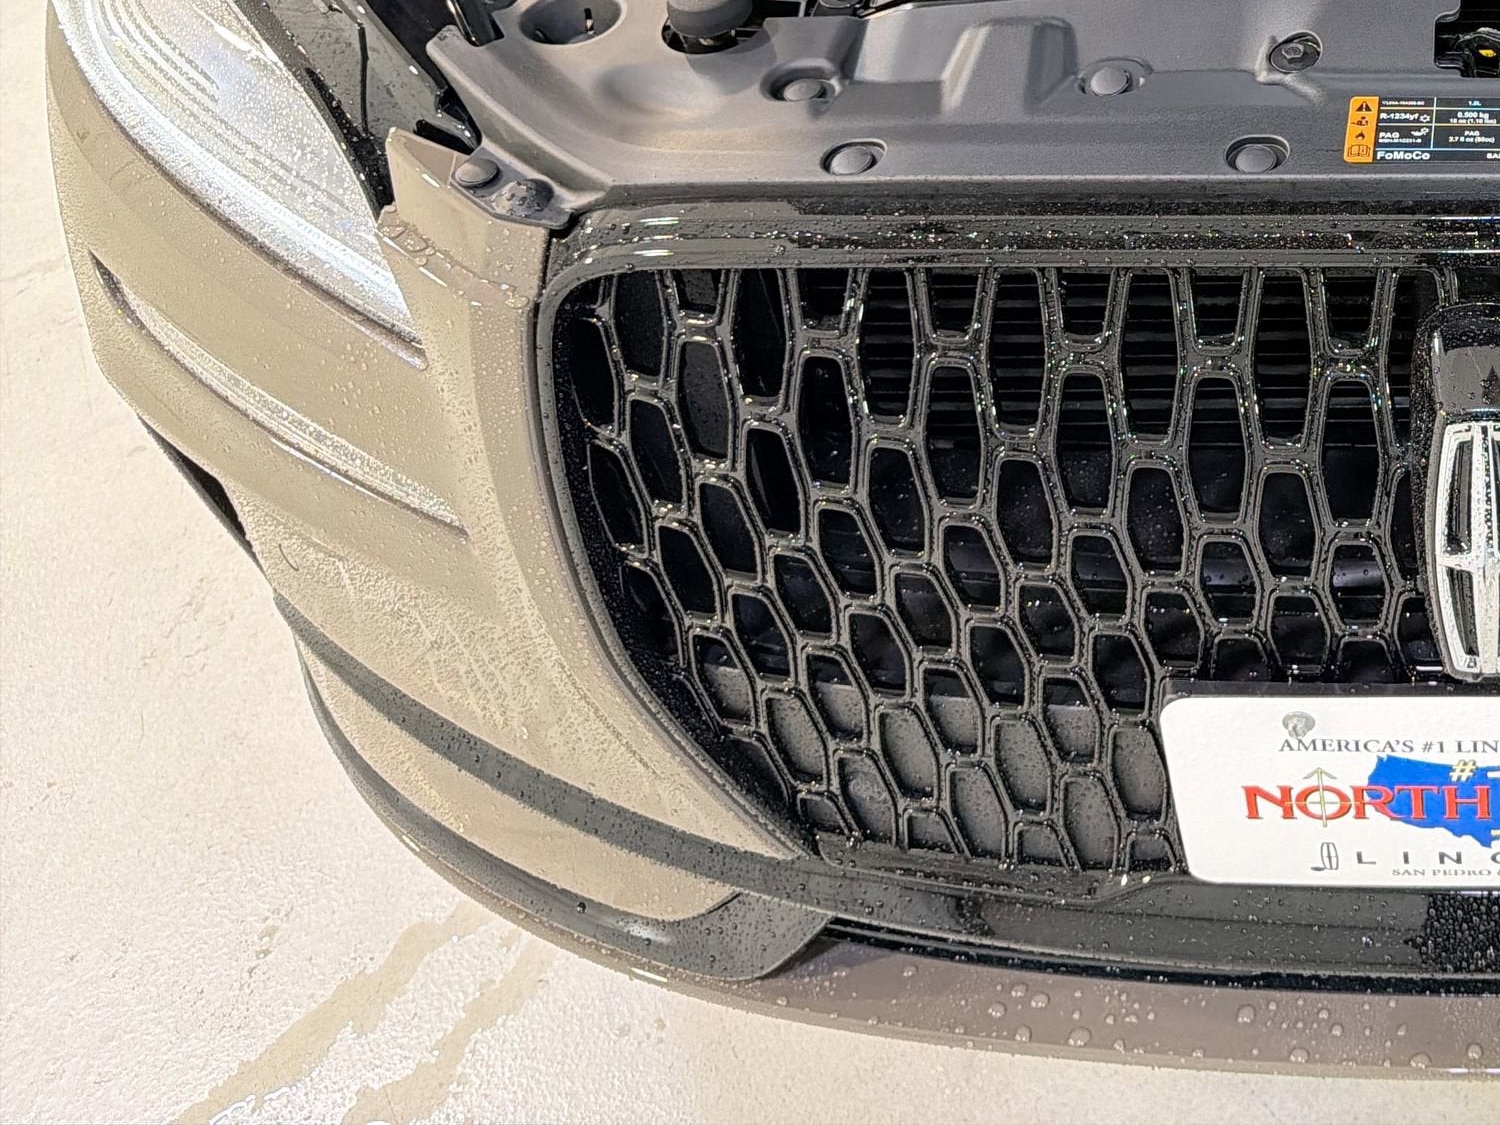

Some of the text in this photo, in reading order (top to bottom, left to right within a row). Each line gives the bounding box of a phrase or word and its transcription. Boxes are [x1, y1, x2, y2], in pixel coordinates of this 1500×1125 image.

[1379, 112, 1420, 122] R-1234yf
[1457, 111, 1490, 120] 0.500 kg
[1379, 131, 1400, 139] PAG
[1376, 151, 1431, 160] FoMoCo
[1278, 738, 1415, 753] AMERICA'S
[1422, 740, 1446, 753] #1
[1241, 785, 1492, 821] NORTH
